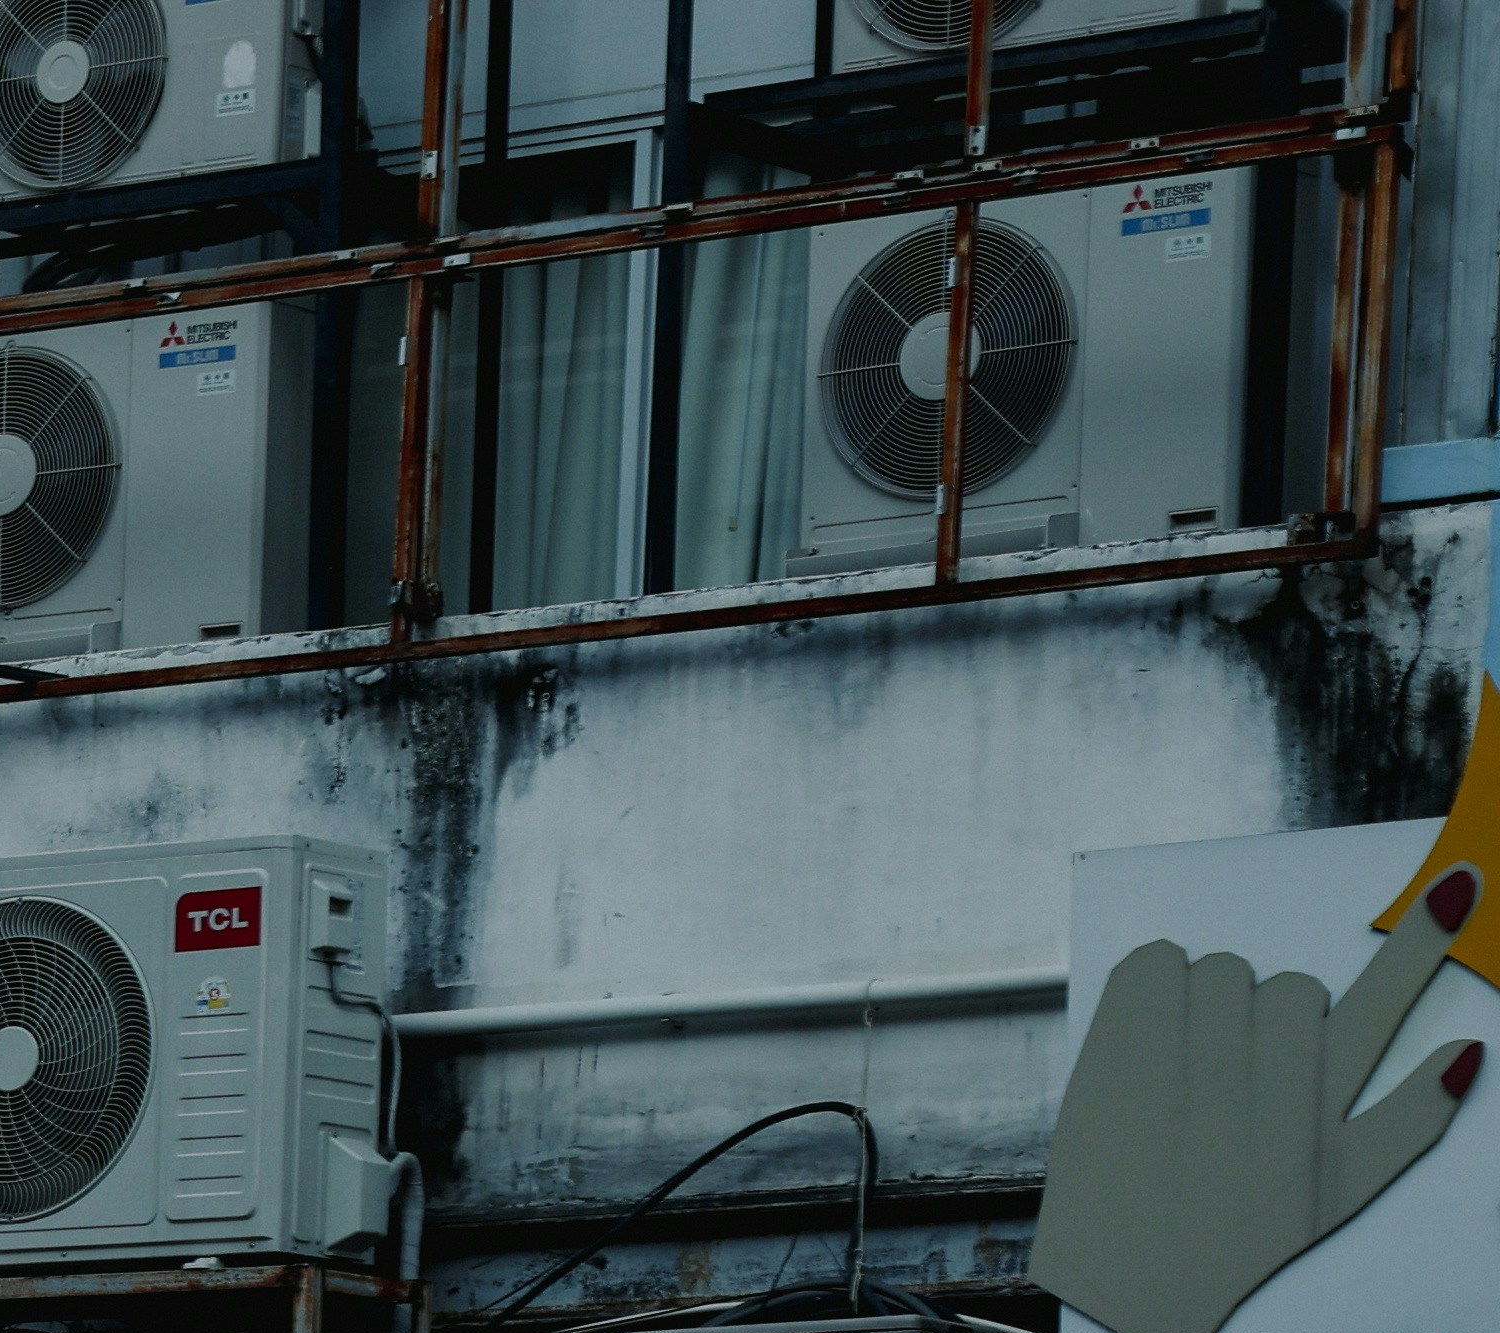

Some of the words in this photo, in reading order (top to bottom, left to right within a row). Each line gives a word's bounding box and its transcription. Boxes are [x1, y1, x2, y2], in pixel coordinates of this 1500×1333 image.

[1154, 180, 1213, 198] MITSUBISHI
[1154, 193, 1204, 208] ELECTRIC
[187, 320, 238, 335] MITSUBISHI
[187, 331, 231, 345] ELECTRIC
[187, 907, 250, 933] TCL
